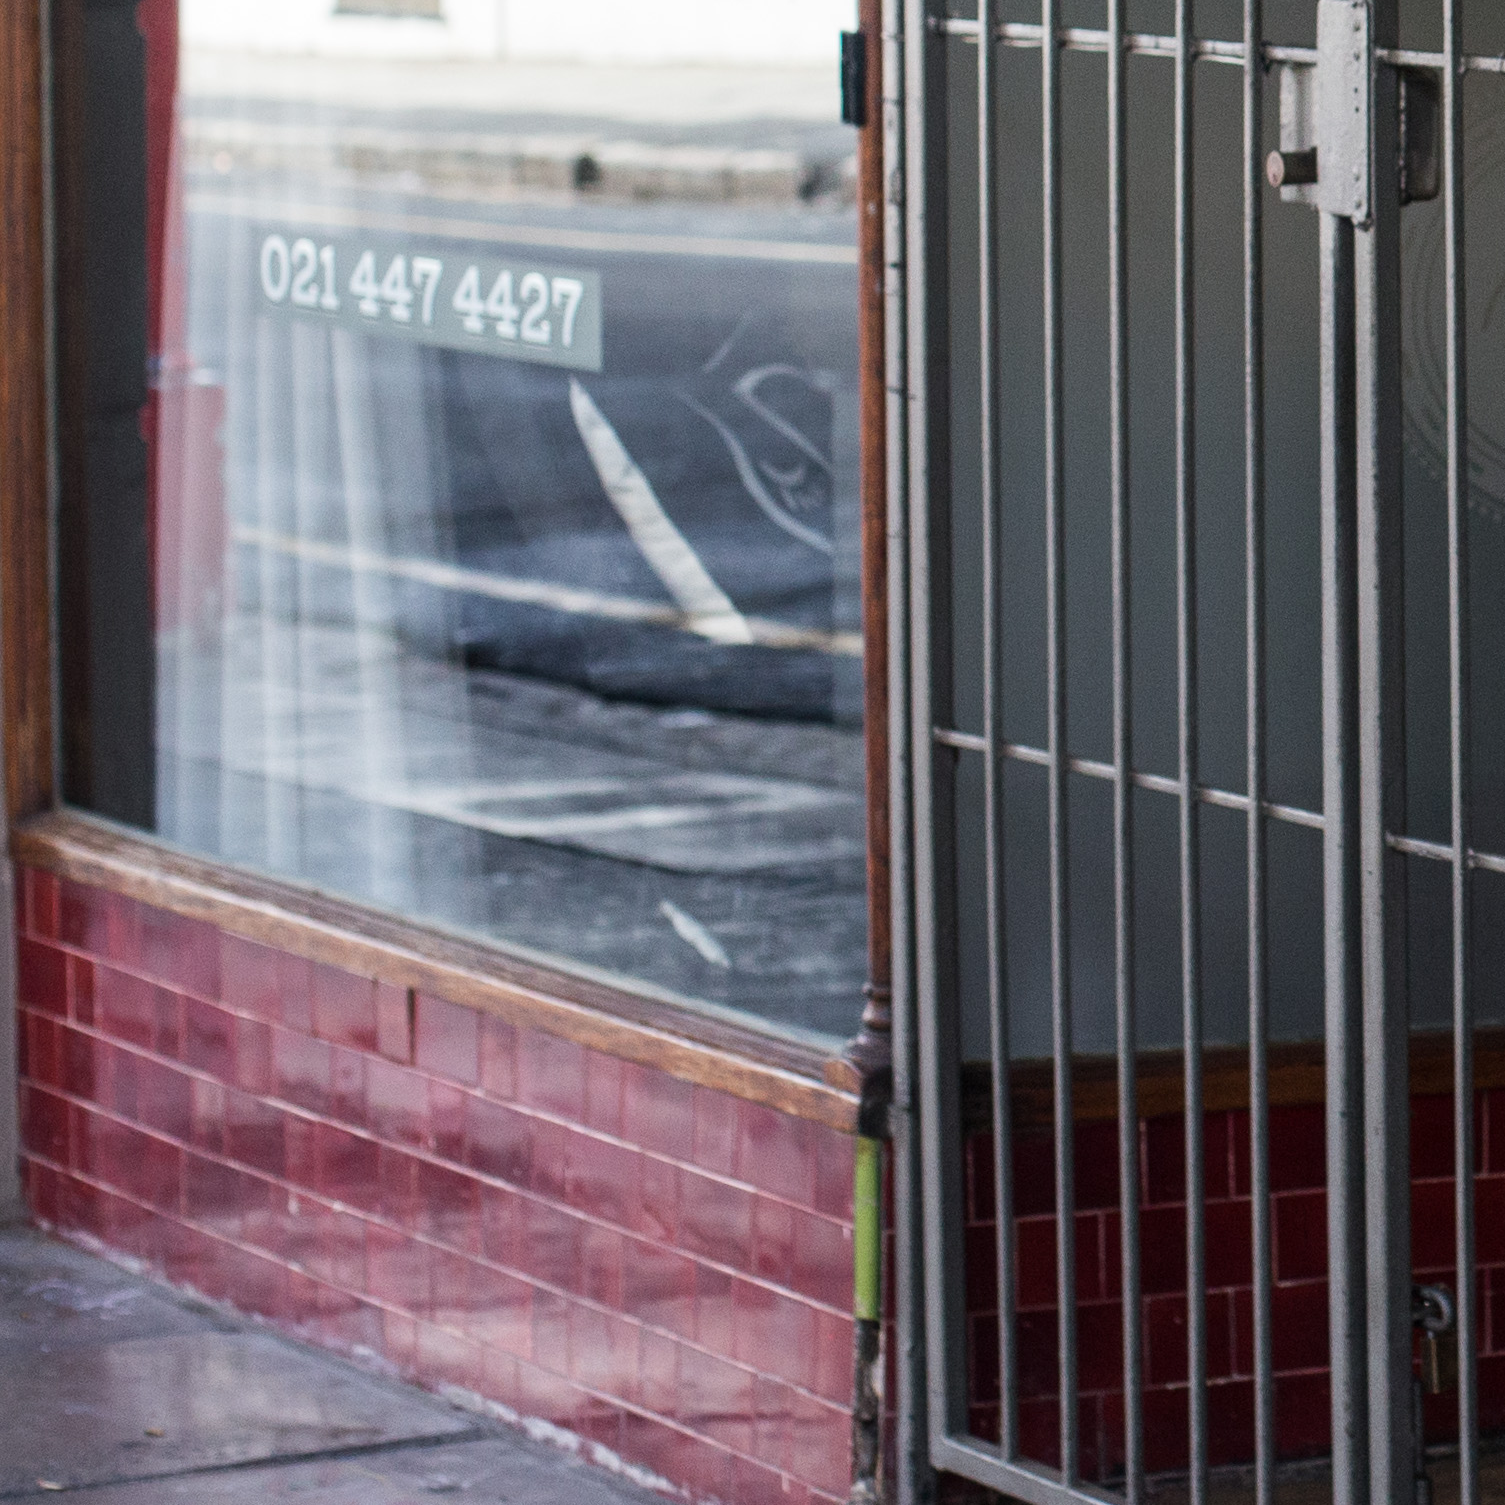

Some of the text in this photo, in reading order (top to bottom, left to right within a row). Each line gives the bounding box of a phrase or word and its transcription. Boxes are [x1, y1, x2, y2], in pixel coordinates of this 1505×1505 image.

[260, 234, 584, 347] 021 447 4427
